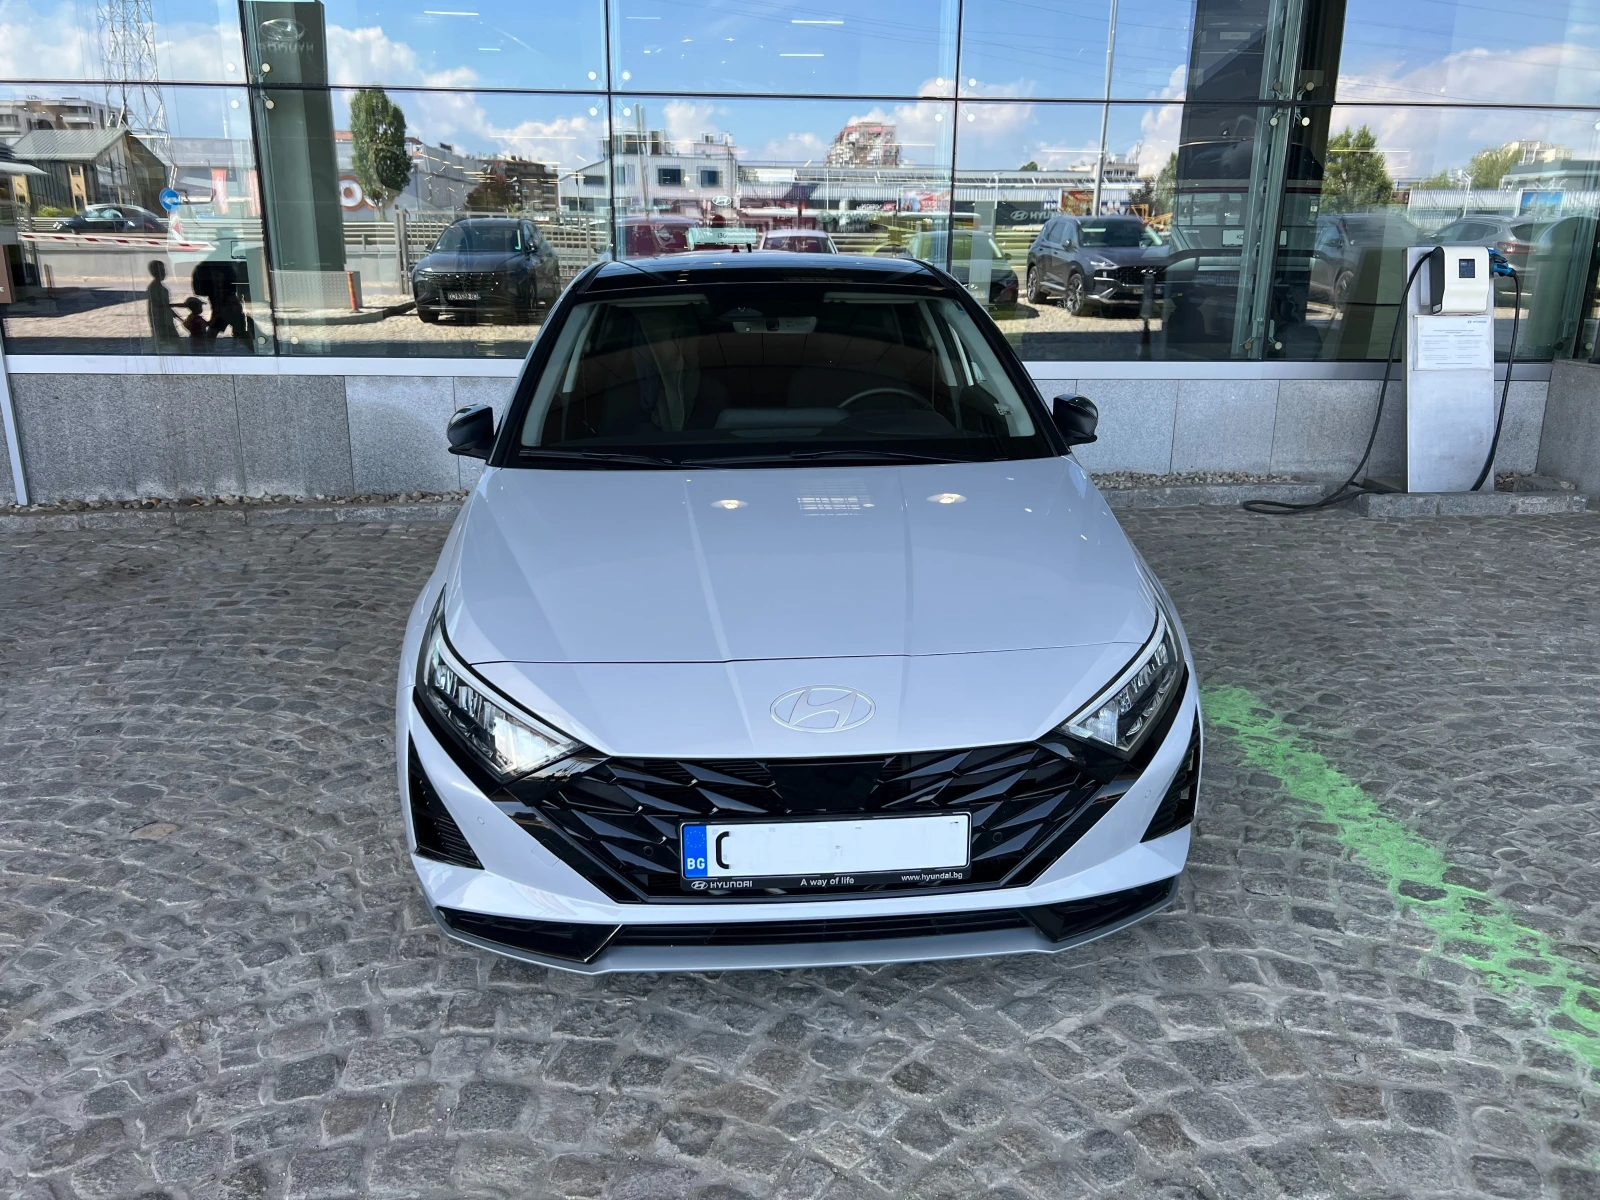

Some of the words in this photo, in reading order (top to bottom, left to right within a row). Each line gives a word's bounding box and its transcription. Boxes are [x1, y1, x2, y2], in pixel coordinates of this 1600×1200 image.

[687, 857, 706, 870] BG
[800, 878, 808, 886] A
[809, 878, 828, 887] way
[829, 876, 840, 885] of
[841, 876, 855, 885] life
[901, 871, 963, 882] www.hyundai.bg
[710, 880, 753, 889] HYUNDAI
